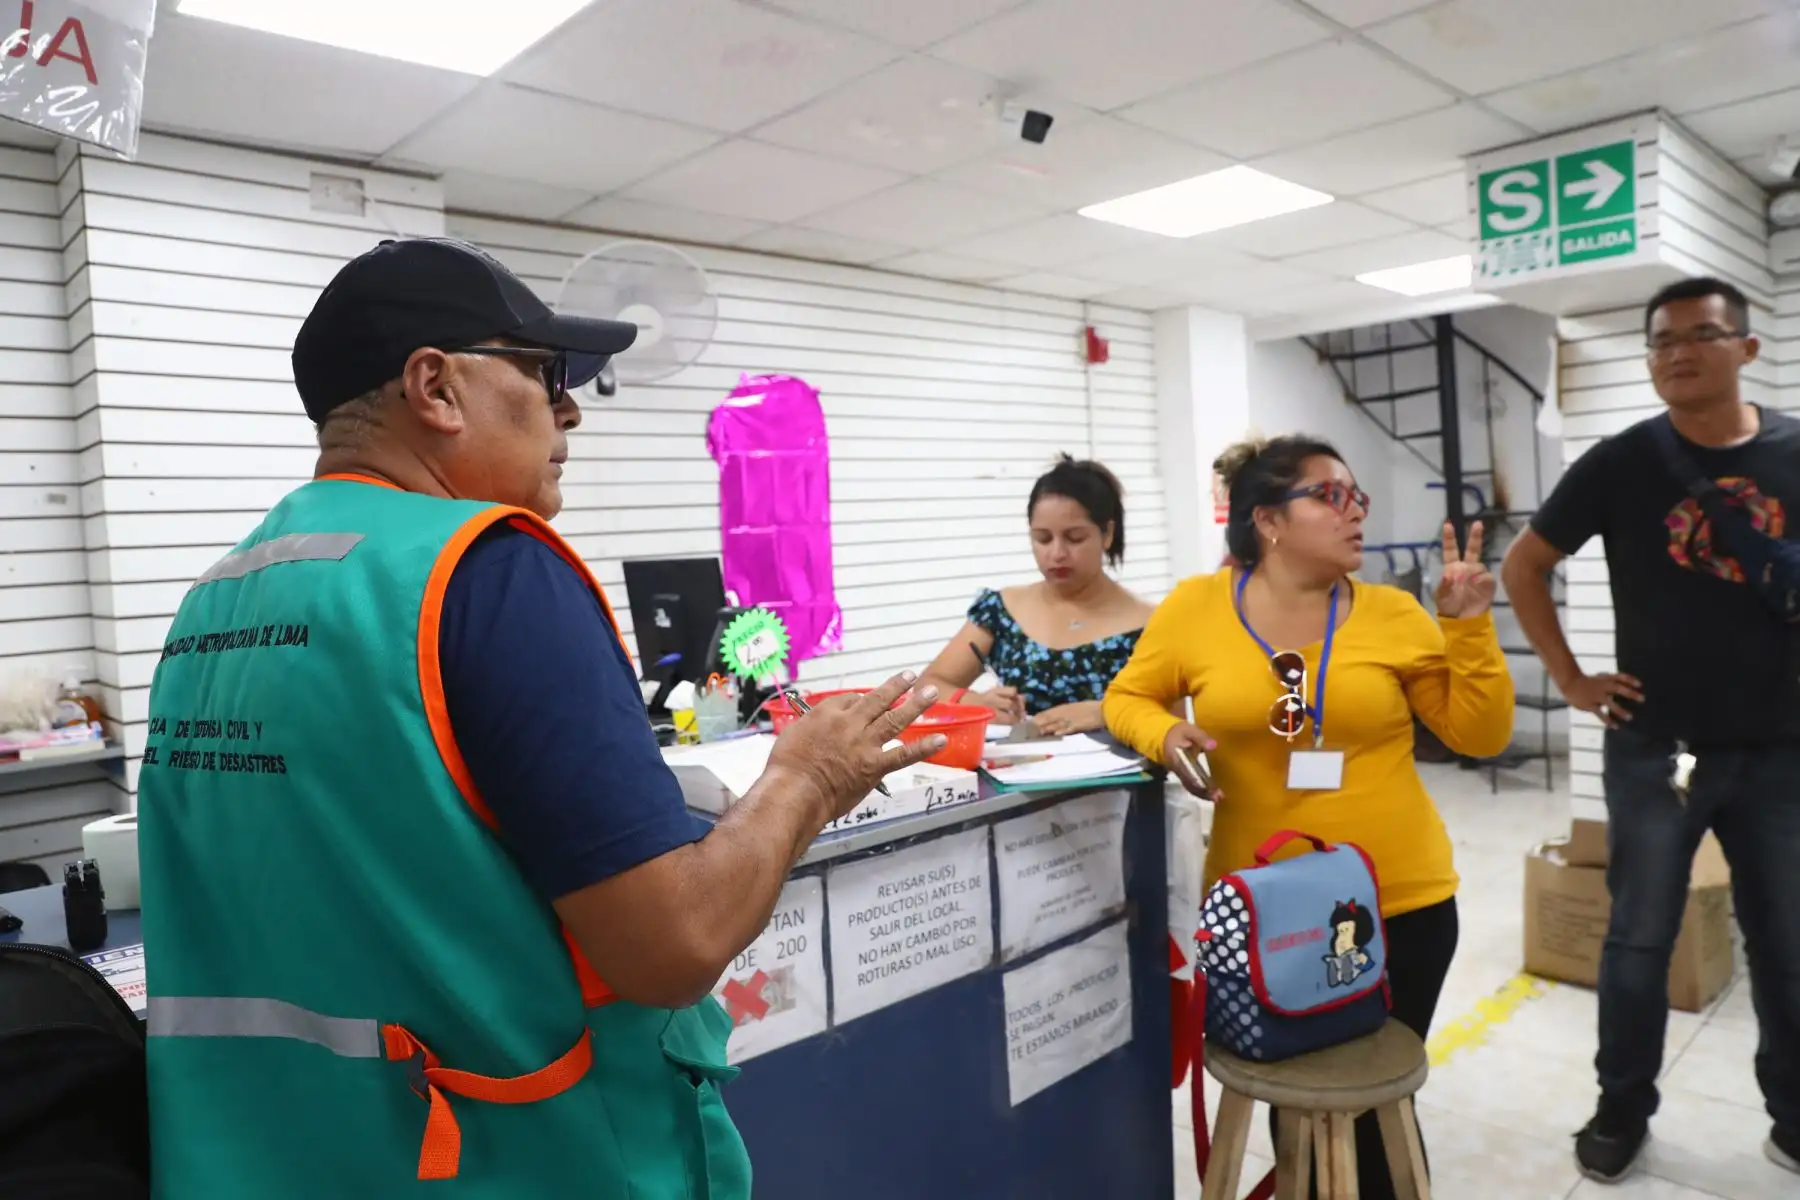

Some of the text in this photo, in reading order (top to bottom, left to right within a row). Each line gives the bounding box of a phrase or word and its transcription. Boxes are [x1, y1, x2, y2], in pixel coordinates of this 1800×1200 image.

[1486, 169, 1544, 232] S
[1561, 228, 1633, 256] SALIDA
[259, 624, 275, 647] DE
[275, 624, 309, 648] LIMA
[174, 719, 191, 739] DE
[226, 719, 251, 741] CIVIL
[254, 721, 263, 741] Y
[202, 751, 216, 772] DE
[219, 752, 287, 775] DESASTRES
[878, 864, 956, 899] REVISAR SU(S)
[848, 875, 982, 928] PRODUCTO(S) ANTES DE
[858, 916, 977, 966] NO HAY CAMBIO POR
[869, 919, 900, 941] SALIR
[904, 912, 925, 930] DEL
[734, 935, 807, 972] DE 200
[857, 934, 977, 987] ROTURAS O MAL USO
[1008, 1000, 1042, 1024] TODOS
[1047, 989, 1064, 1008] LOS
[1010, 1027, 1020, 1042] SE
[1011, 998, 1118, 1061] TE ESTAMOS MIRANDO
